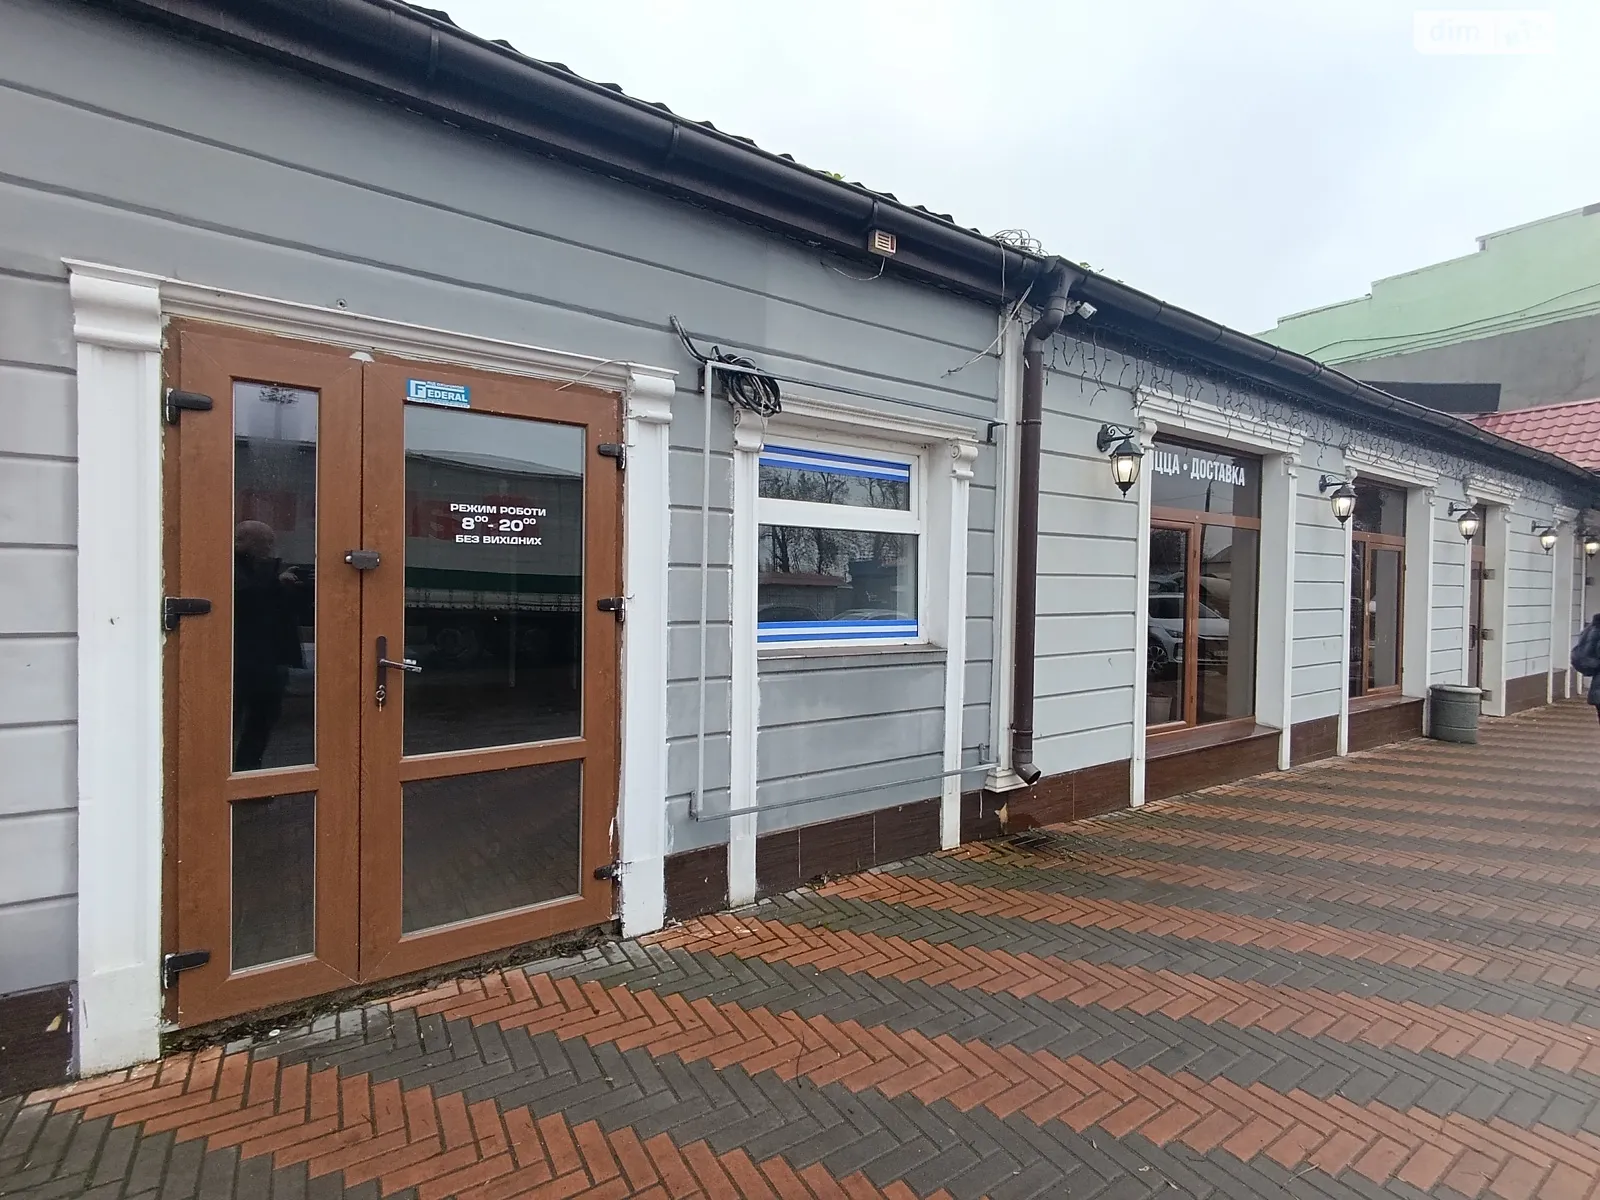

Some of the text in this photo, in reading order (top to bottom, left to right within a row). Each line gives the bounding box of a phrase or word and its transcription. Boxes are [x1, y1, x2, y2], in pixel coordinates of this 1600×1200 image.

[410, 380, 469, 402] FEDERAL
[1151, 451, 1245, 487] ЦЦА ДОСТАВКА
[450, 503, 547, 517] РЕЖИМ РОБОТИ
[455, 534, 542, 546] БЕЗ ВИХІДНИХ
